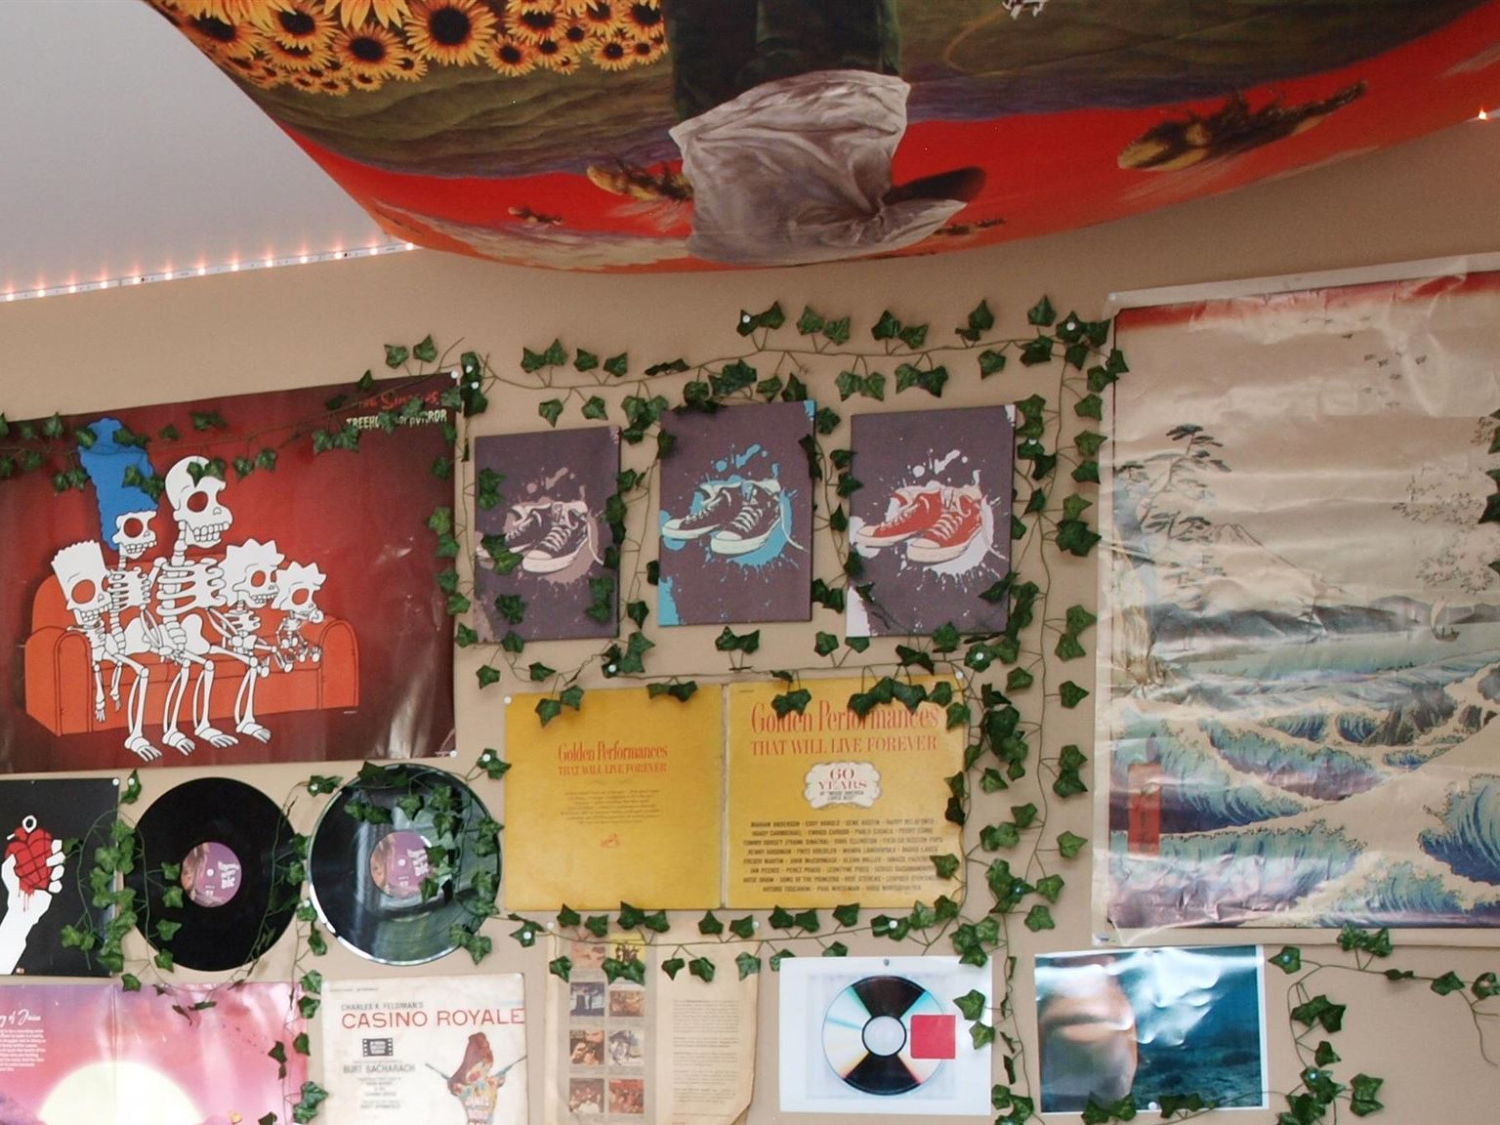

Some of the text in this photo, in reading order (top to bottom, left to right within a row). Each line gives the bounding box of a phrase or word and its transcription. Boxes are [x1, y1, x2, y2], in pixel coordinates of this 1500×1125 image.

[751, 735, 938, 756] THAT WILL LIVE FOREVER
[830, 769, 855, 781] 60
[818, 781, 867, 790] YEARS
[341, 1007, 526, 1030] CASINO ROYALE
